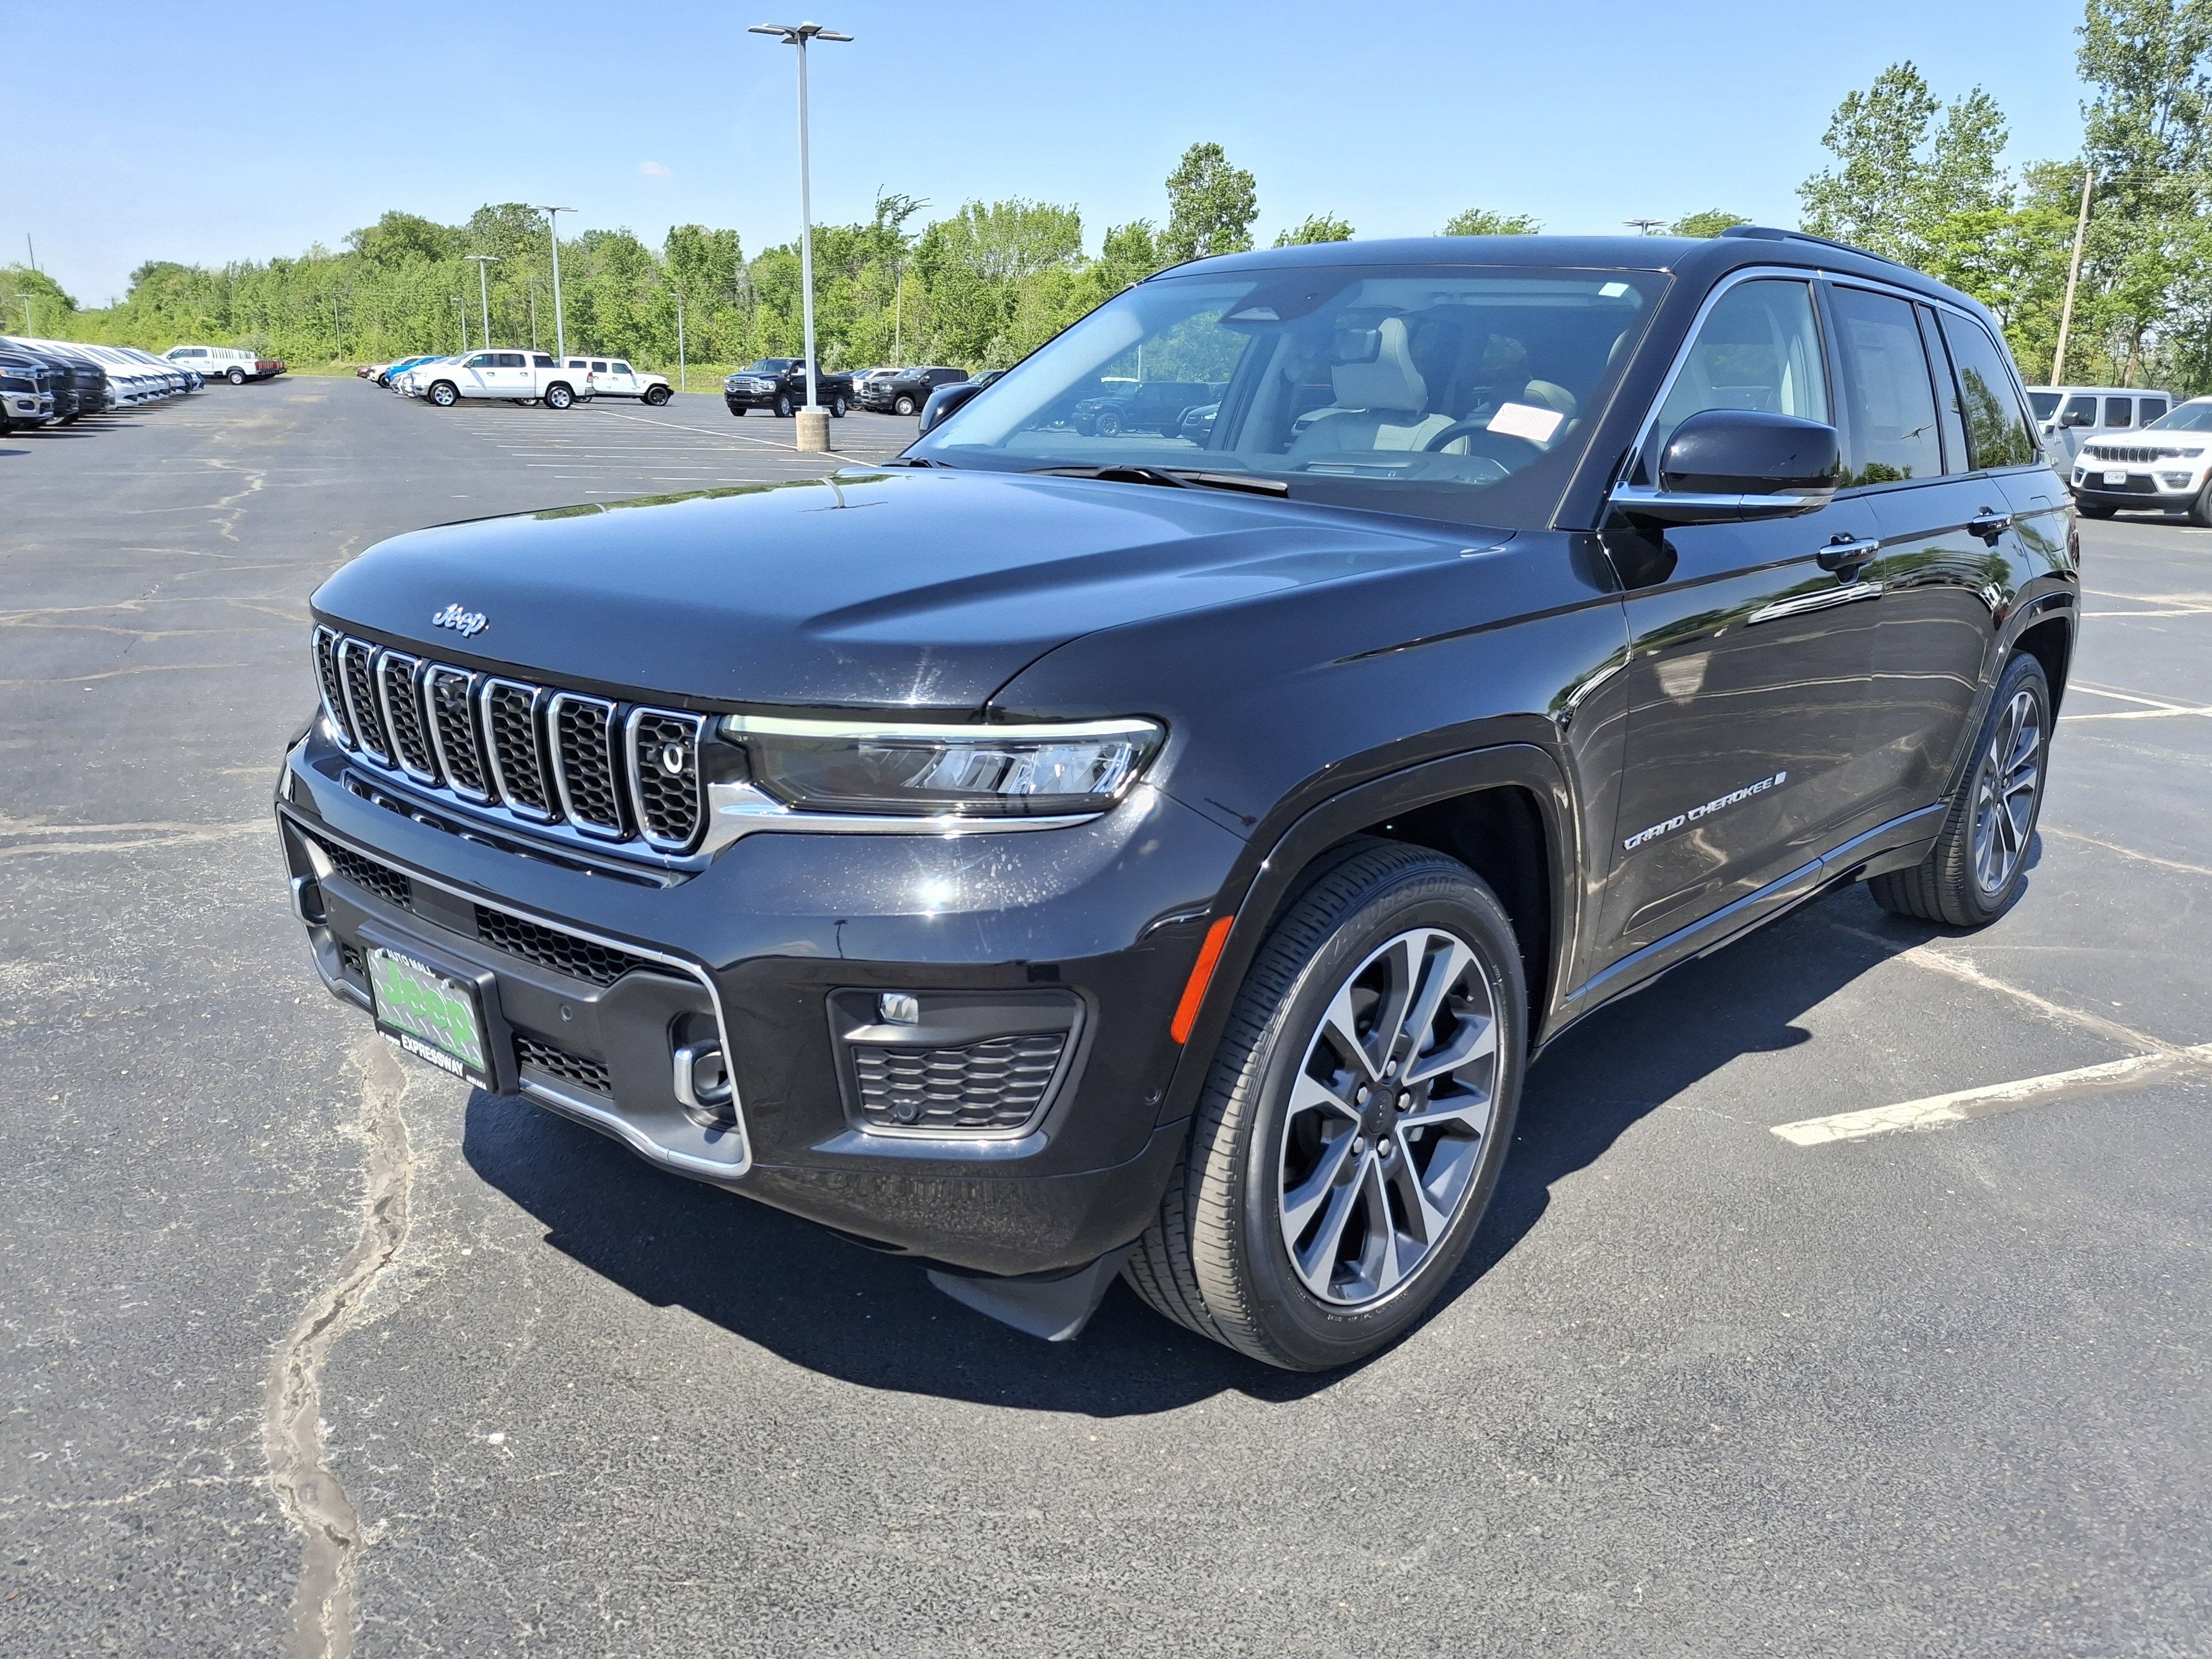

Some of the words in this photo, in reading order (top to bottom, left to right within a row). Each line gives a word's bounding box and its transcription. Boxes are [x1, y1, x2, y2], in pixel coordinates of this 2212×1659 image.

[432, 603, 487, 638] Jeep
[1623, 814, 1685, 850] GRAND
[1687, 777, 1773, 821] CHEROKEE
[386, 948, 410, 967] AUTO
[409, 957, 436, 978] MALL
[383, 959, 472, 1049] Jeep
[401, 1033, 463, 1077] EXPRESSWAY
